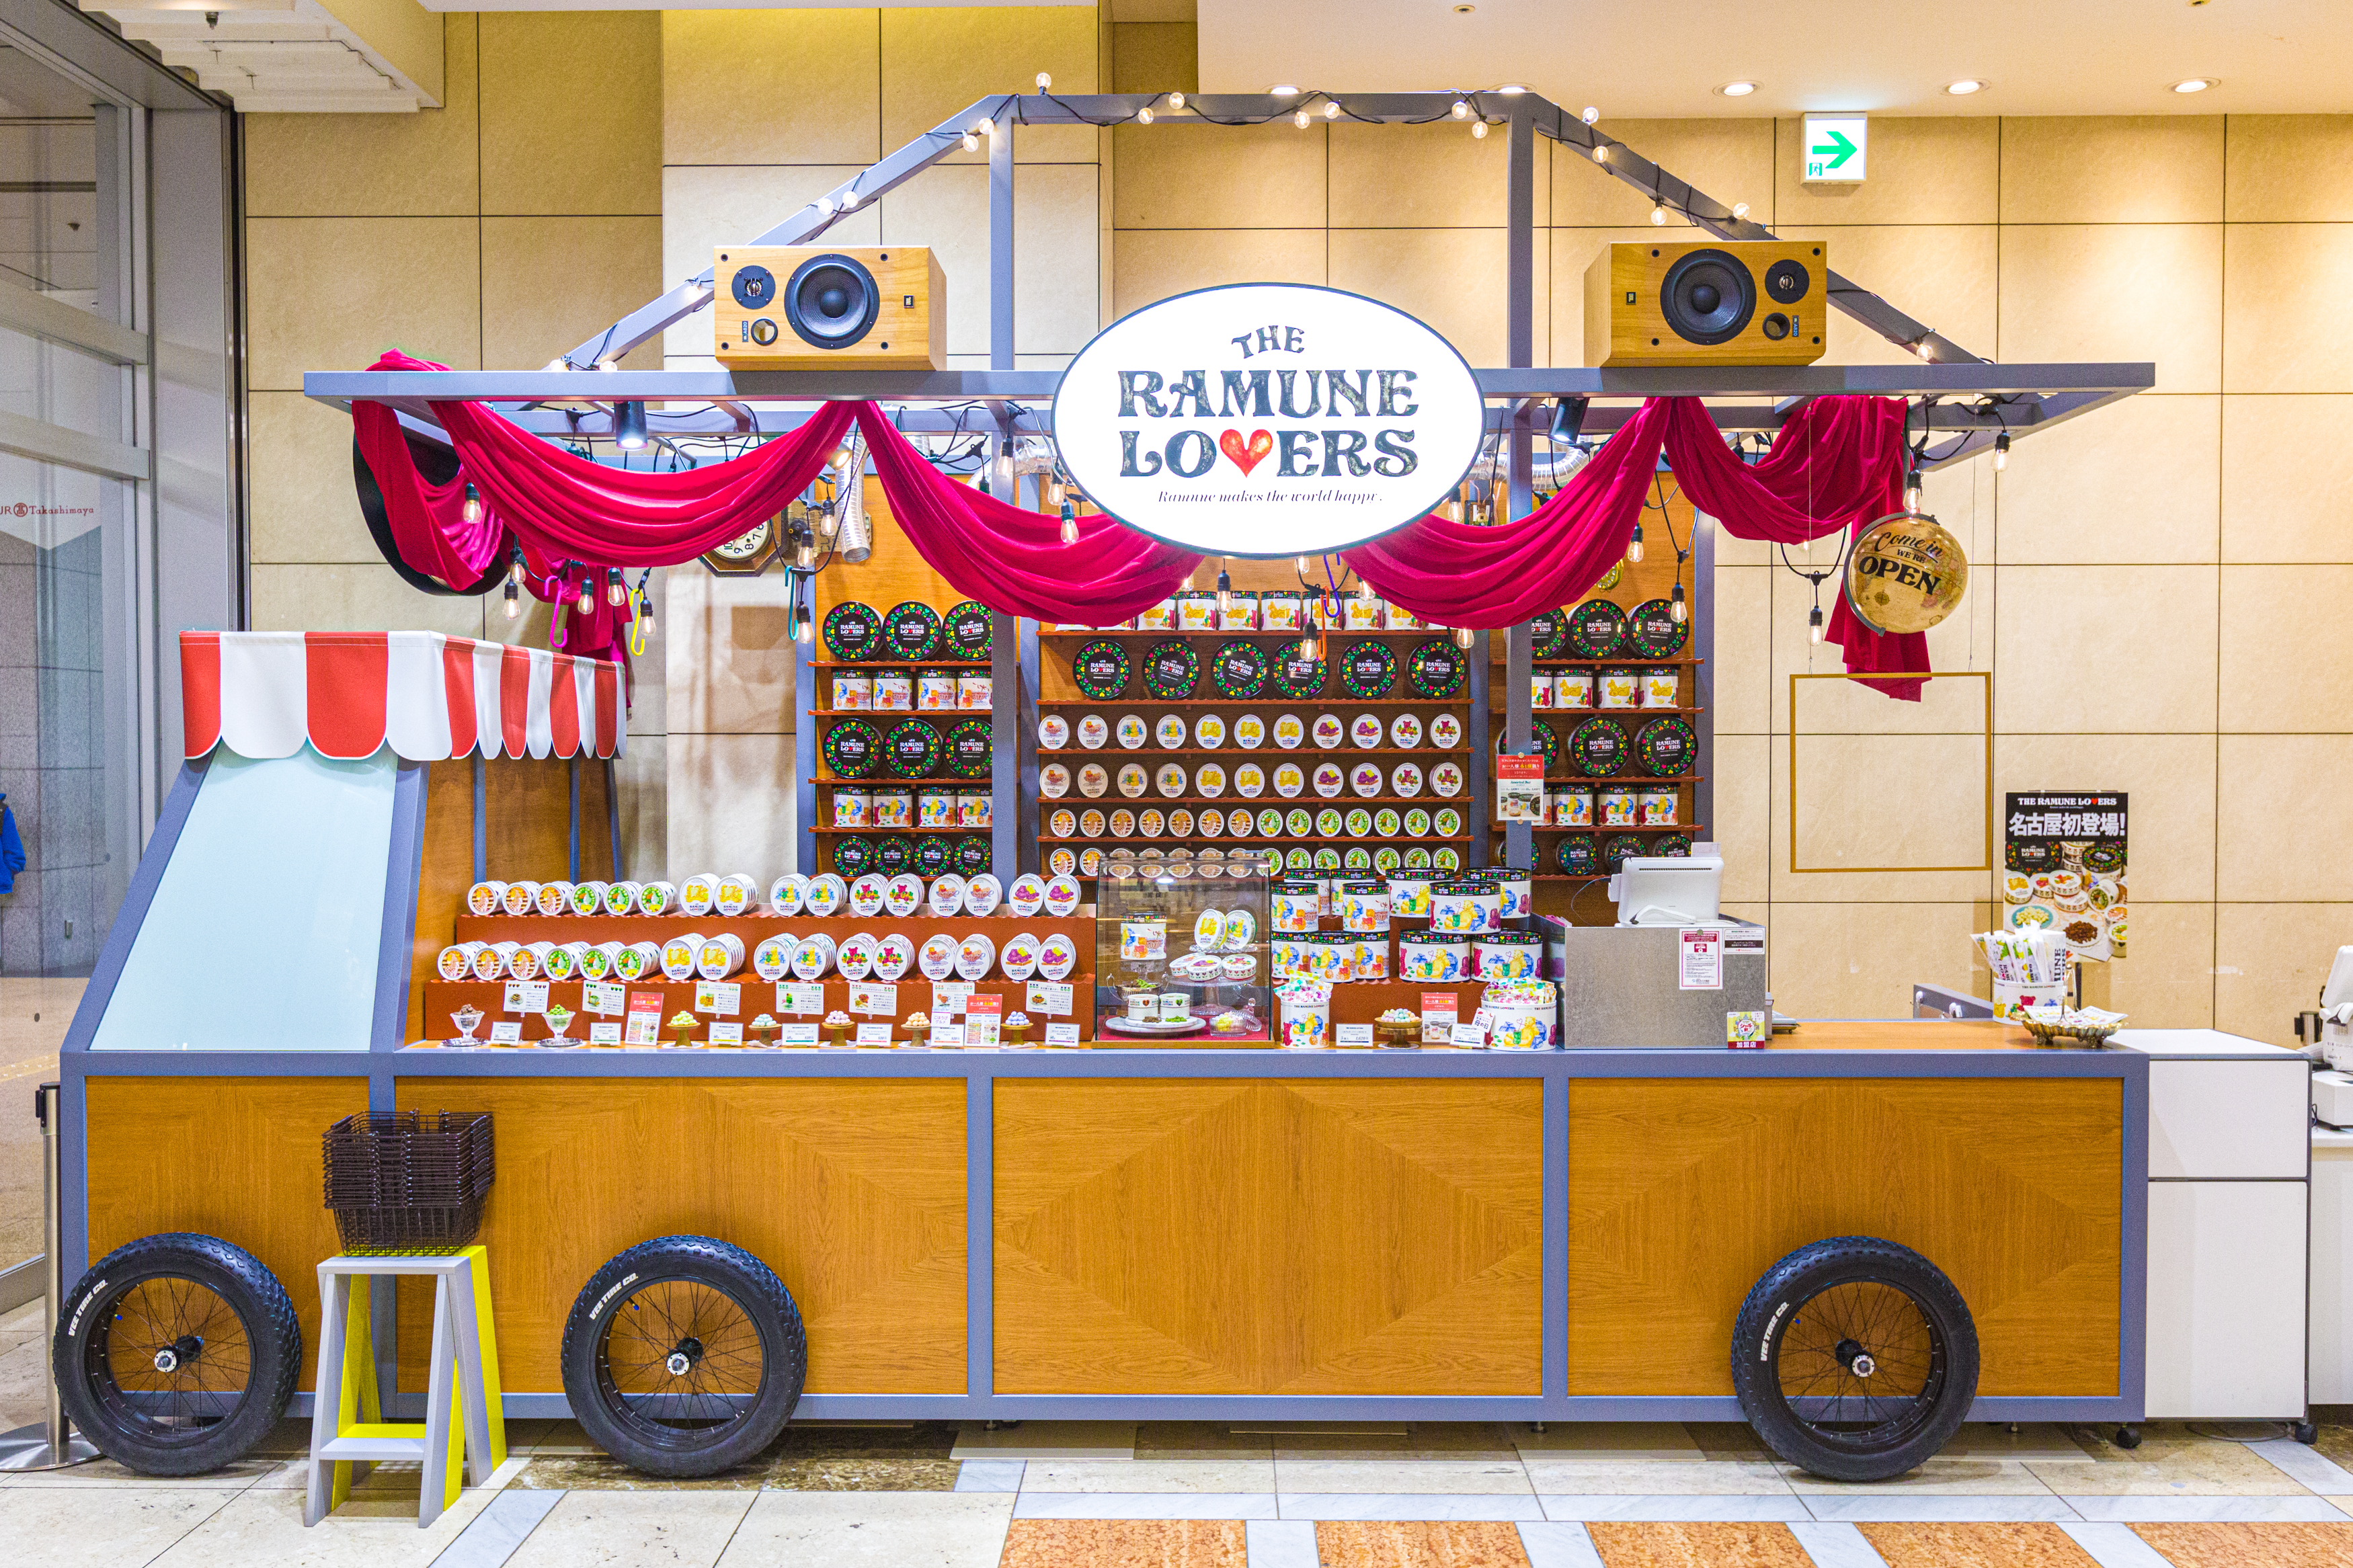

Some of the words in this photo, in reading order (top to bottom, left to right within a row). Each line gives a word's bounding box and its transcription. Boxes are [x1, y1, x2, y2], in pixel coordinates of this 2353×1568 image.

[1231, 325, 1306, 360] THE
[1117, 370, 1419, 418] RAMUNE
[1159, 491, 1215, 502] Ramune
[1220, 490, 1263, 502] makes
[1267, 490, 1287, 502] the
[1291, 489, 1332, 502] world
[29, 505, 94, 516] Takashimaya
[723, 542, 733, 550] 10
[1874, 532, 1926, 552] Come
[1926, 540, 1944, 557] in
[1897, 549, 1925, 563] WE'RE
[1859, 556, 1942, 595] OPEN
[1474, 1020, 1489, 1030] 母の日
[589, 1301, 604, 1320] VEE
[601, 1282, 623, 1304] TIRE
[622, 1272, 639, 1286] CO.
[68, 1315, 79, 1337] VEE
[76, 1291, 93, 1317] TIRE
[93, 1279, 108, 1295] CO.
[1776, 1301, 1790, 1318] CO.
[1763, 1315, 1778, 1341] TIRE
[1760, 1340, 1769, 1362] VEE
